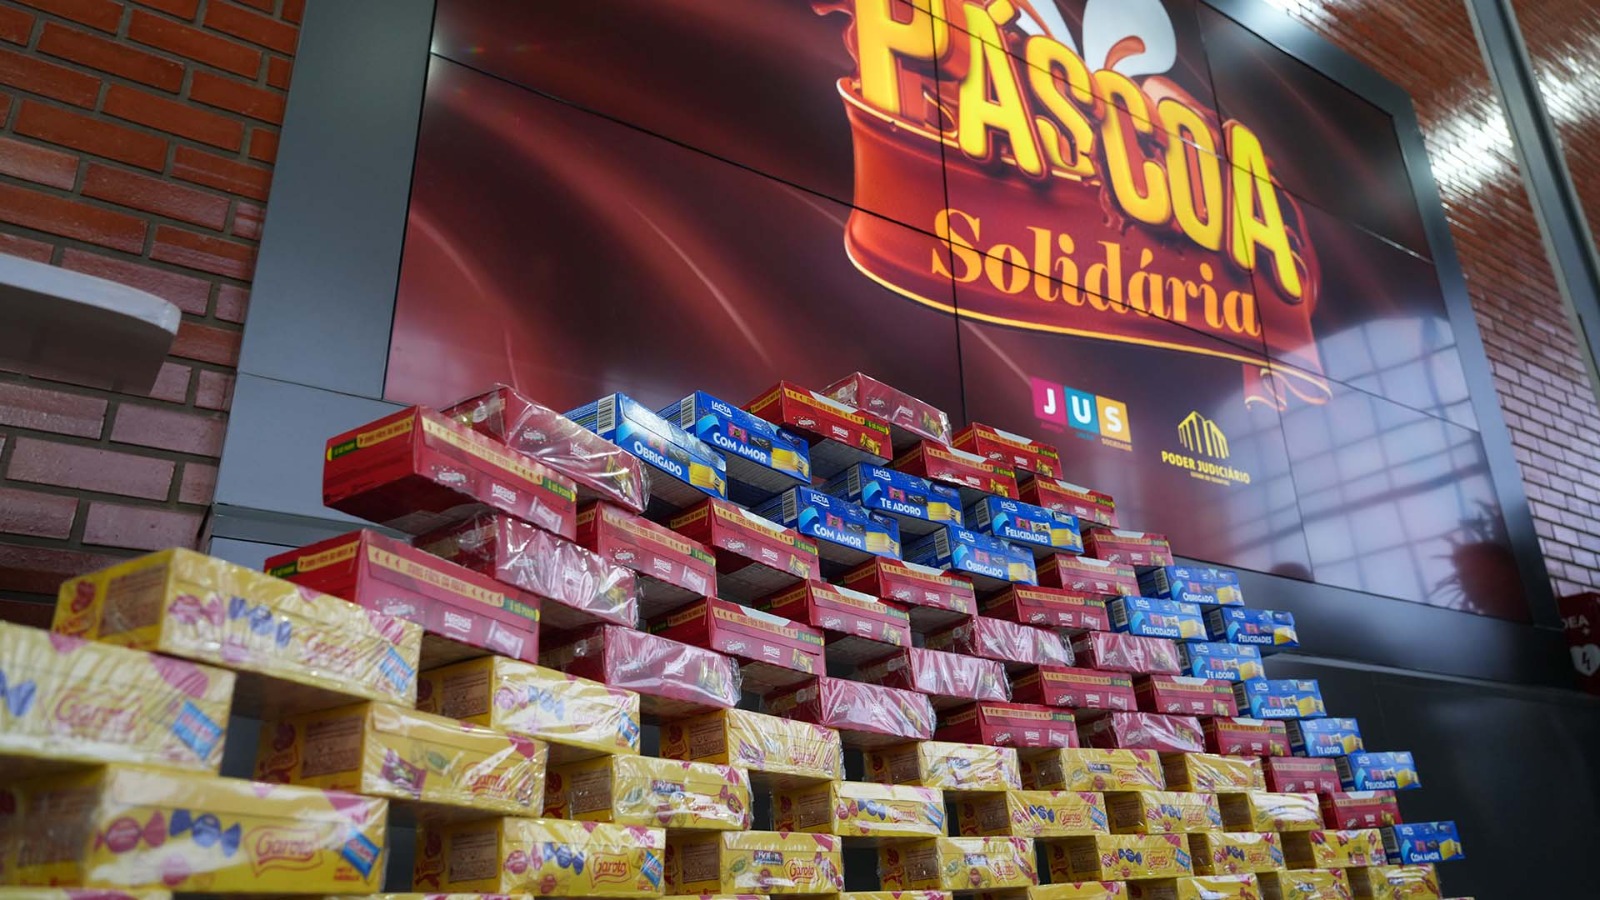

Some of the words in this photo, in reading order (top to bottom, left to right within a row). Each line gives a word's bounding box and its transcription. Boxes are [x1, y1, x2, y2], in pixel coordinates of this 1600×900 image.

[851, 0, 1303, 298] PÁSCOA
[931, 208, 1261, 337] Solidária
[1043, 387, 1123, 433] JUS
[633, 441, 683, 477] OBRIGADO
[713, 432, 737, 452] COM
[738, 447, 767, 463] AMOR
[1161, 450, 1196, 471] PODER
[1197, 459, 1251, 485] JUDICIÁRIO
[880, 497, 892, 510] TE
[893, 501, 921, 516] ADORO
[813, 523, 835, 540] COM
[836, 532, 862, 548] AMOR
[1005, 526, 1048, 544] FELICIDADES
[966, 560, 1003, 577] OBRIGADO
[1142, 624, 1178, 637] FELICIDADES
[1238, 633, 1272, 644] FELICIDADES
[1261, 707, 1297, 717] FELICIDADES
[256, 832, 315, 864] Garoto
[593, 853, 627, 879] Garoto
[790, 862, 815, 880] Garoto
